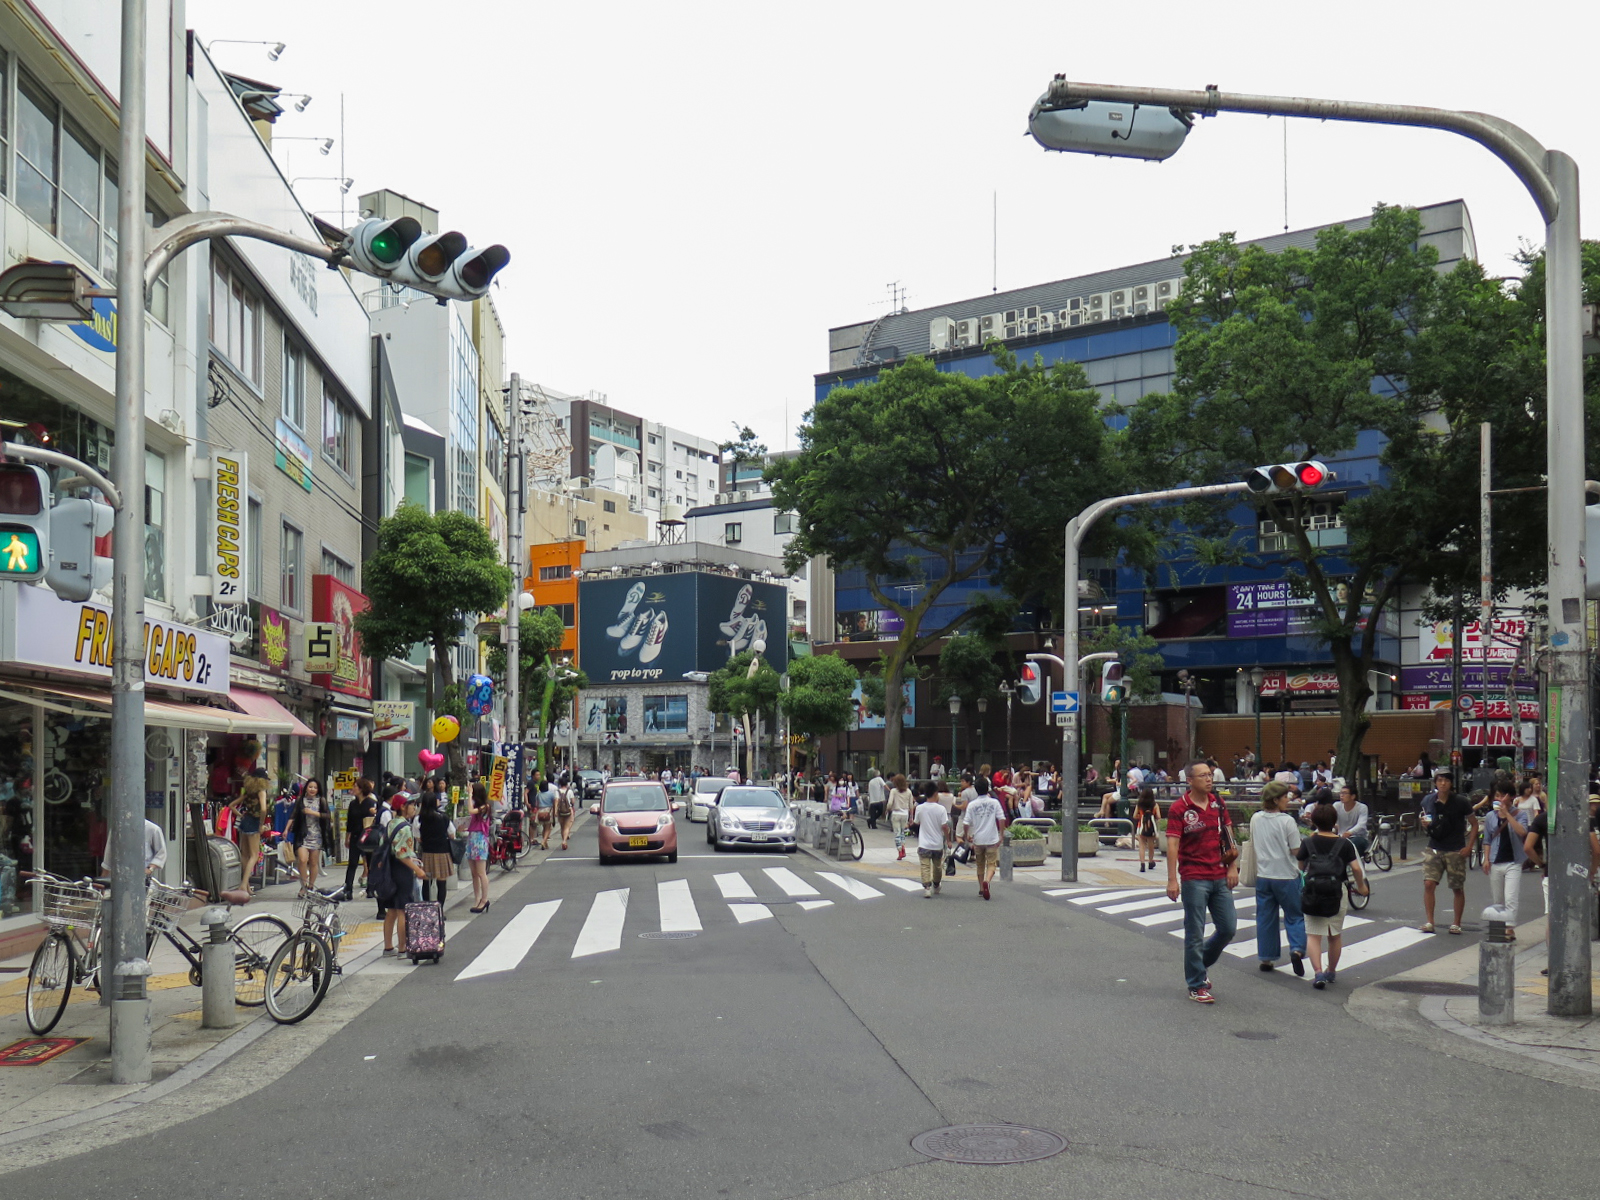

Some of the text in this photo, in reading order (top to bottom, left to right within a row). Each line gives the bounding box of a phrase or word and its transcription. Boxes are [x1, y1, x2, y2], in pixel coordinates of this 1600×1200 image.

[216, 456, 240, 595] FRESH CAPS 2F
[1236, 592, 1254, 610] 24
[1257, 590, 1285, 600] HOURS
[308, 625, 333, 658] 占
[148, 623, 197, 682] CAPS
[195, 653, 212, 685] 2F
[610, 666, 663, 681] TOP to TOP
[1263, 679, 1280, 688] 入口
[1441, 671, 1498, 682] AYTIME
